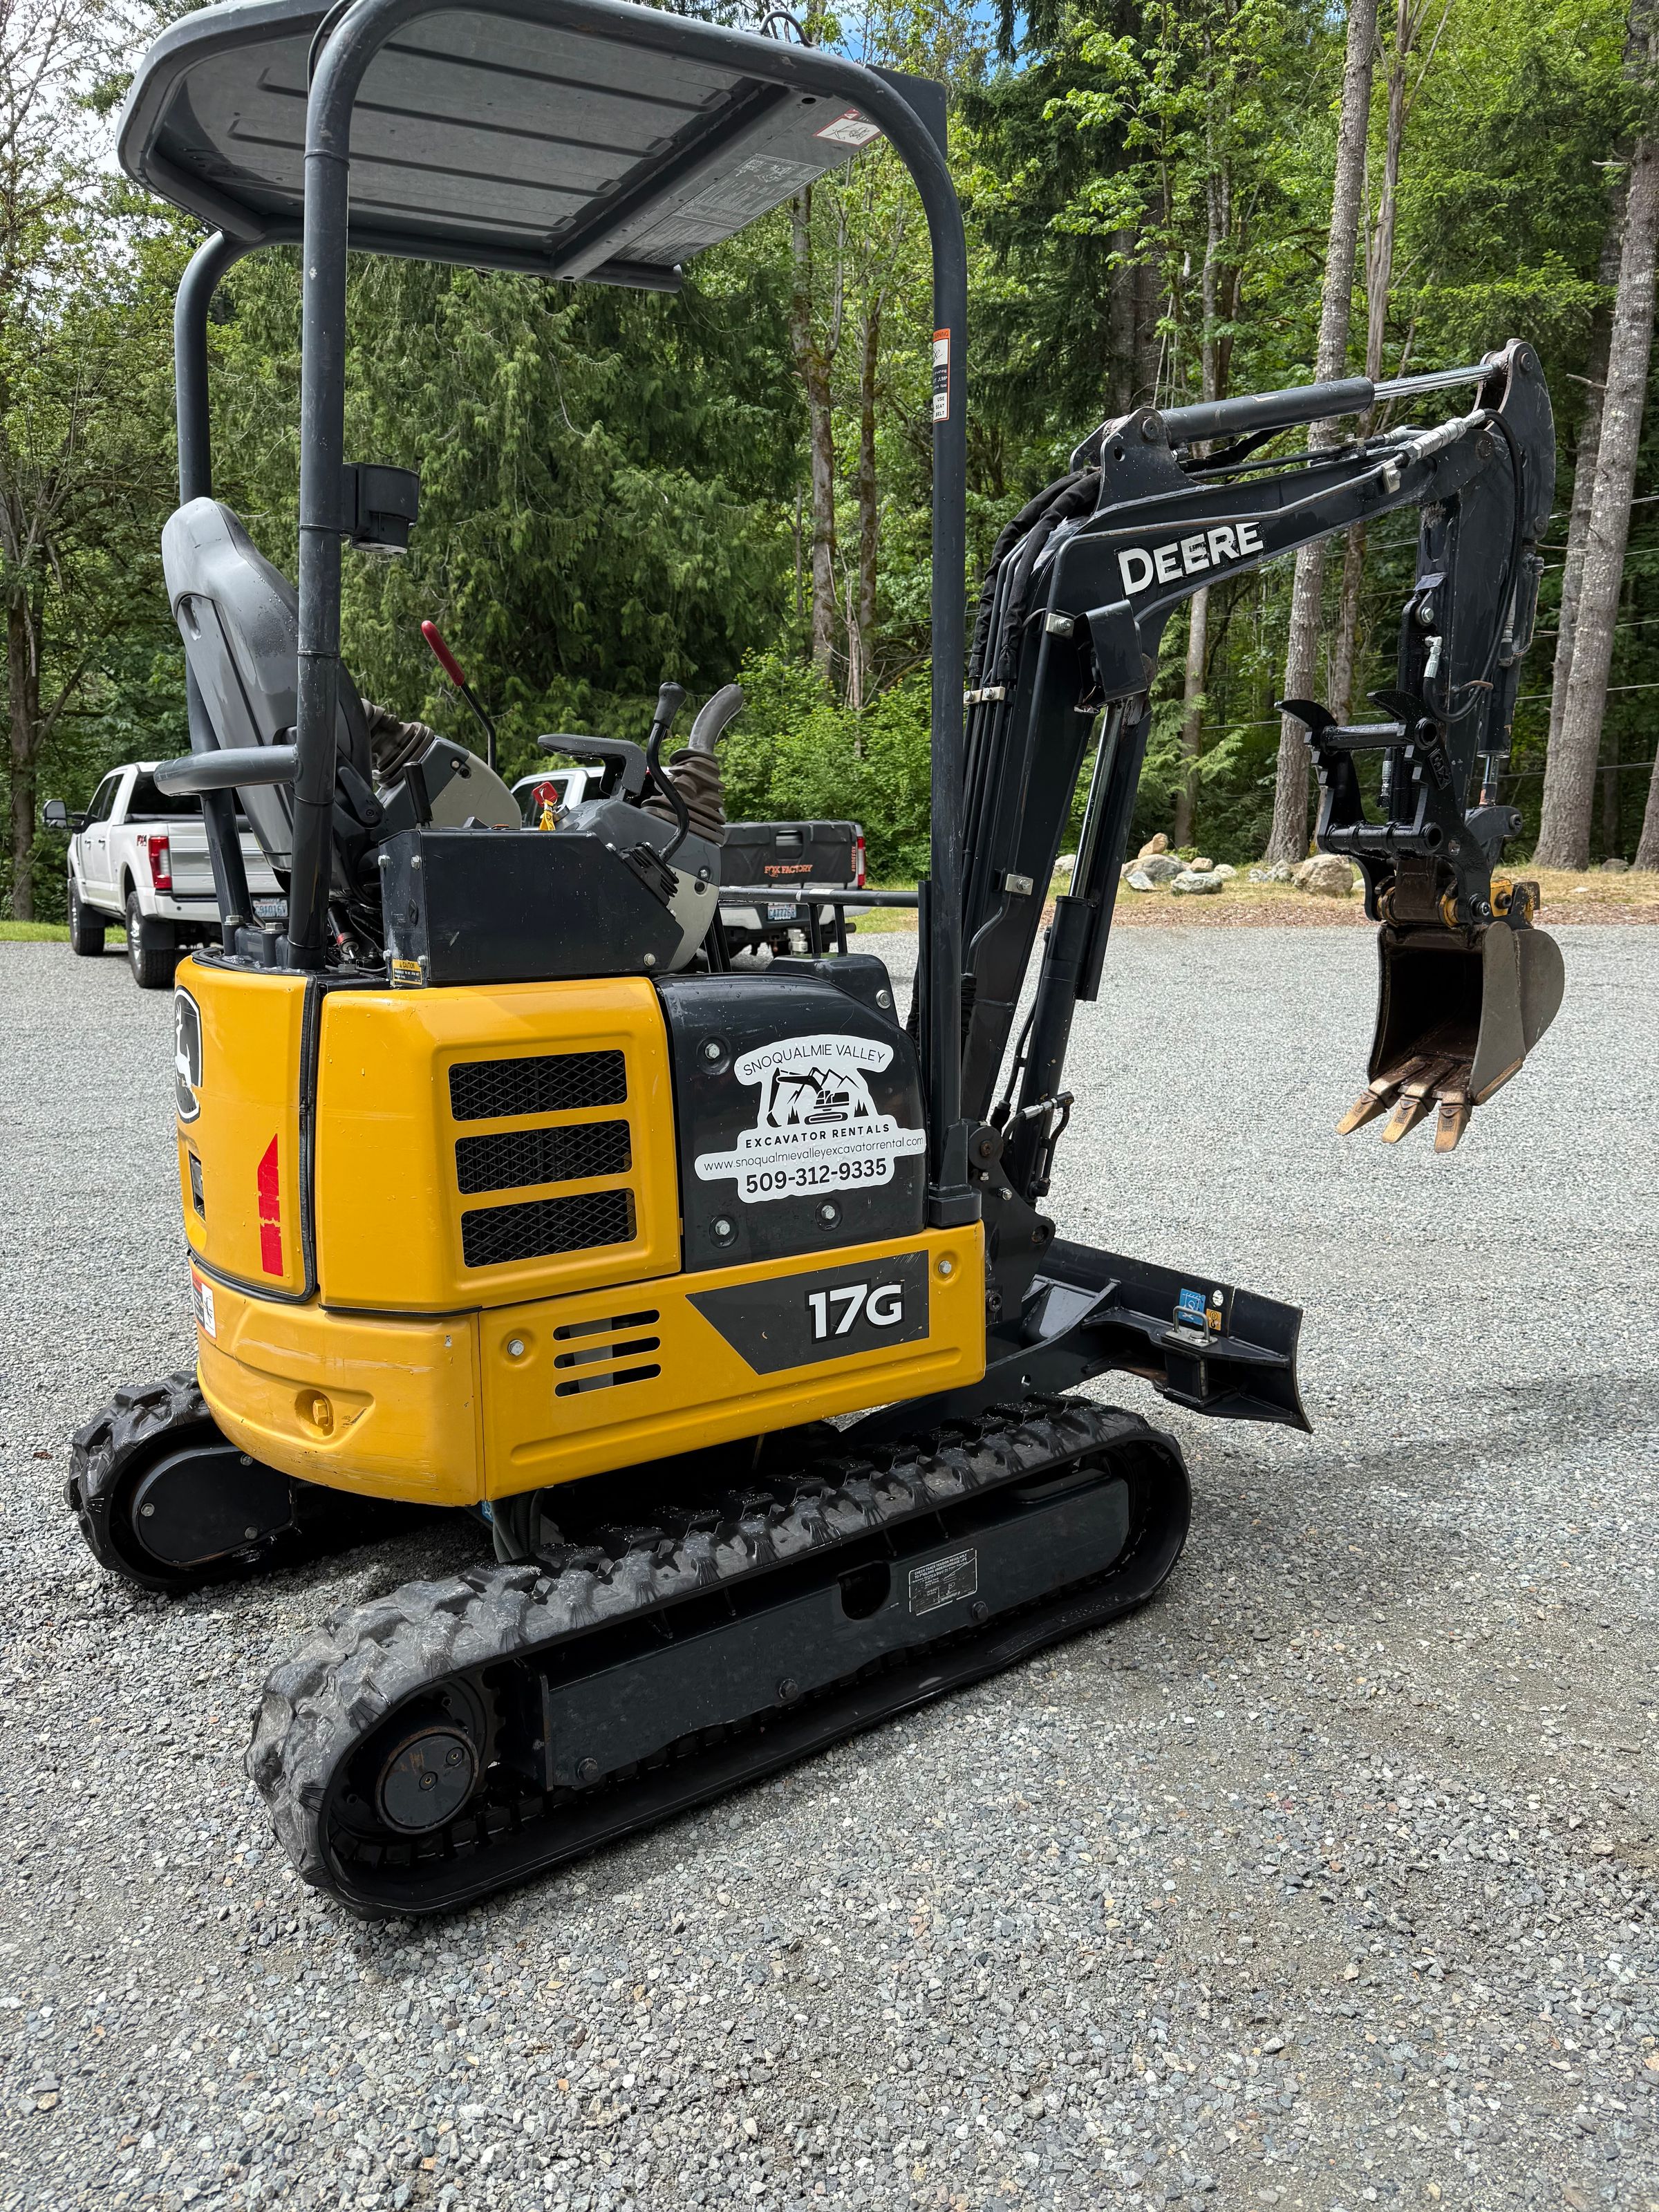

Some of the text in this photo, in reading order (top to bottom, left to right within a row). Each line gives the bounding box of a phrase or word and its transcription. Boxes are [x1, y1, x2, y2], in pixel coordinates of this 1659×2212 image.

[1118, 522, 1264, 596] DEERE
[764, 864, 813, 878] FOX FACTORY
[743, 1044, 885, 1076] SNOQUALMIE VALLEY
[745, 1123, 890, 1148] EXCAVATOR RENTALS
[704, 1136, 924, 1171] www.snoqualmievalleyexcavatorrental.com
[746, 1158, 887, 1194] 509-312-9335
[809, 1284, 902, 1339] 17G
